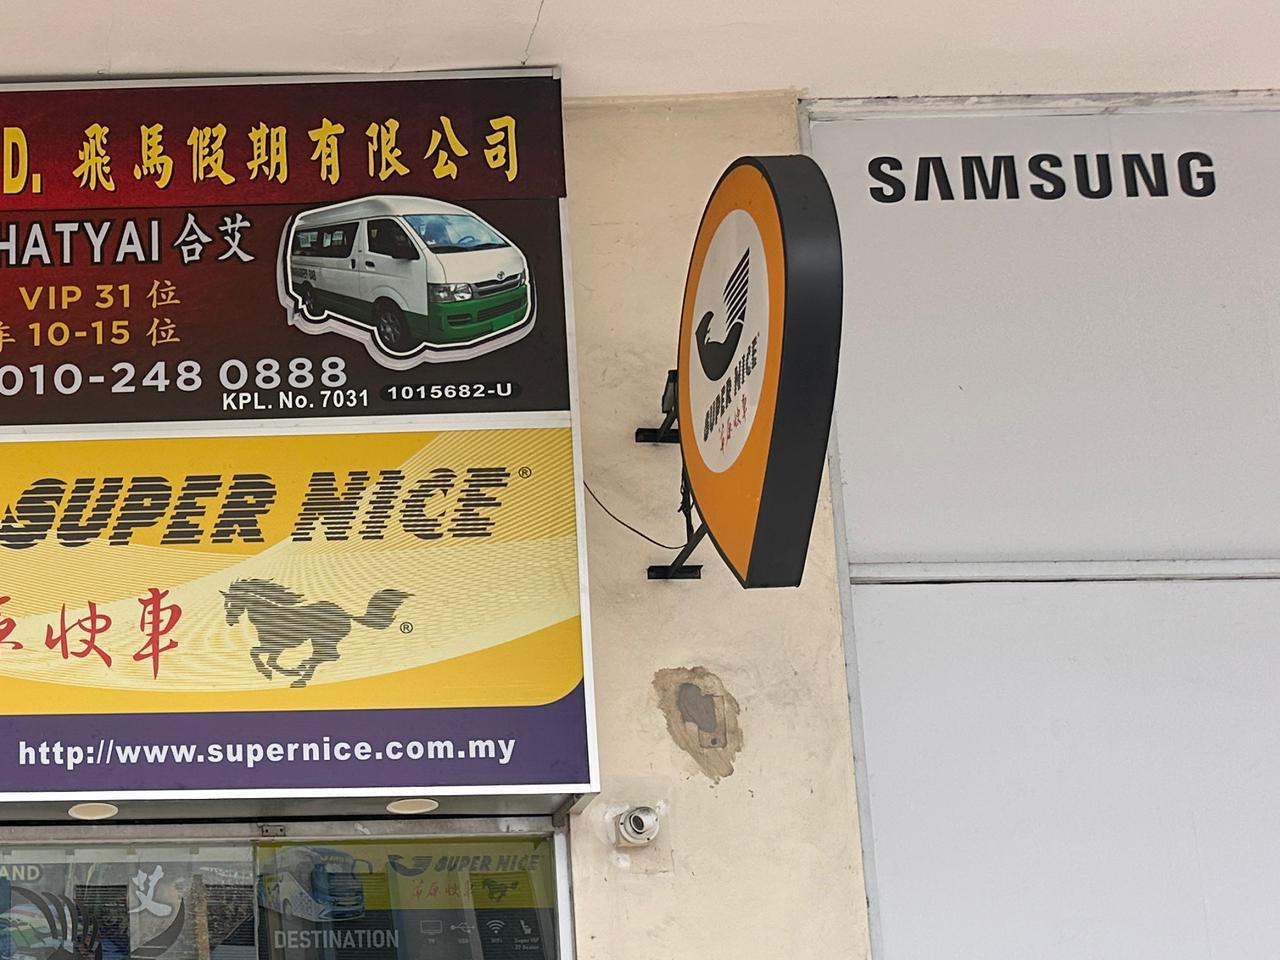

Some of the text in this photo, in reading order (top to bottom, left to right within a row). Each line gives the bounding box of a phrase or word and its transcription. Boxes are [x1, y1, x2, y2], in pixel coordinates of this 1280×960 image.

[73, 115, 521, 192] 飛馬假期有限公司
[868, 152, 1216, 203] SAMSUNG
[173, 213, 256, 265] 合艾
[20, 287, 81, 311] VIP
[96, 284, 132, 309] 31
[147, 280, 182, 308] 位
[29, 321, 130, 348] 10-15
[147, 318, 181, 345] 位
[220, 357, 347, 389] 0888
[222, 382, 513, 411] KPL. No. 7031 1015682-U
[290, 466, 510, 543] NICE
[18, 736, 517, 769] http://www.supernice.com.my
[434, 854, 540, 872] SUPER NICE
[274, 929, 399, 949] DESTINATION
